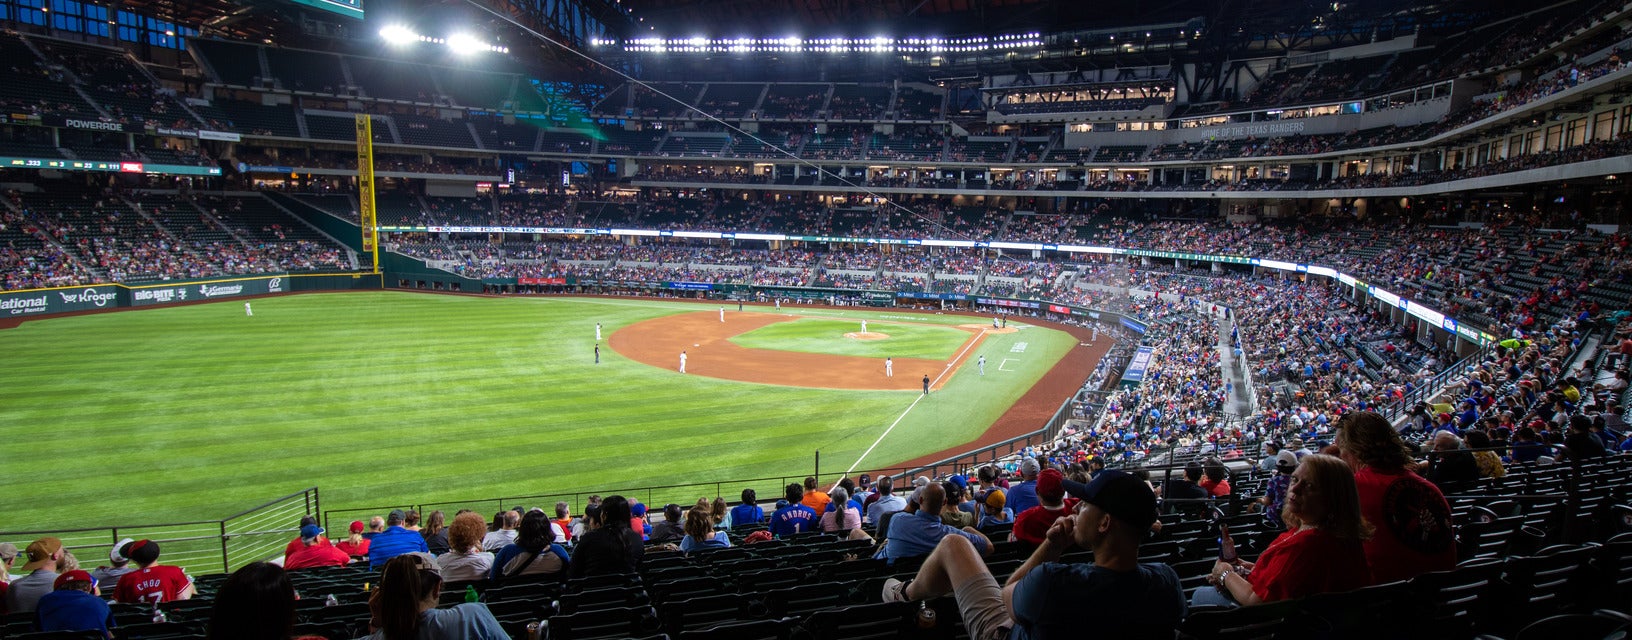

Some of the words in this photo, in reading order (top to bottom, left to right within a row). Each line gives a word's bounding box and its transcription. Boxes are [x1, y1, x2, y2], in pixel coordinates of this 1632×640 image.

[66, 119, 123, 131] POWERADE
[1201, 129, 1219, 138] HOME
[1220, 128, 1230, 137] OF
[1231, 127, 1244, 136] THE
[1246, 126, 1267, 135] TEXAS
[1269, 121, 1304, 133] RANGERS
[79, 288, 117, 306] Kroger
[153, 289, 175, 300] BITE
[781, 510, 812, 521] ANDRUS
[794, 522, 801, 535] 1
[137, 579, 161, 591] CHOO
[138, 590, 163, 610] 17
